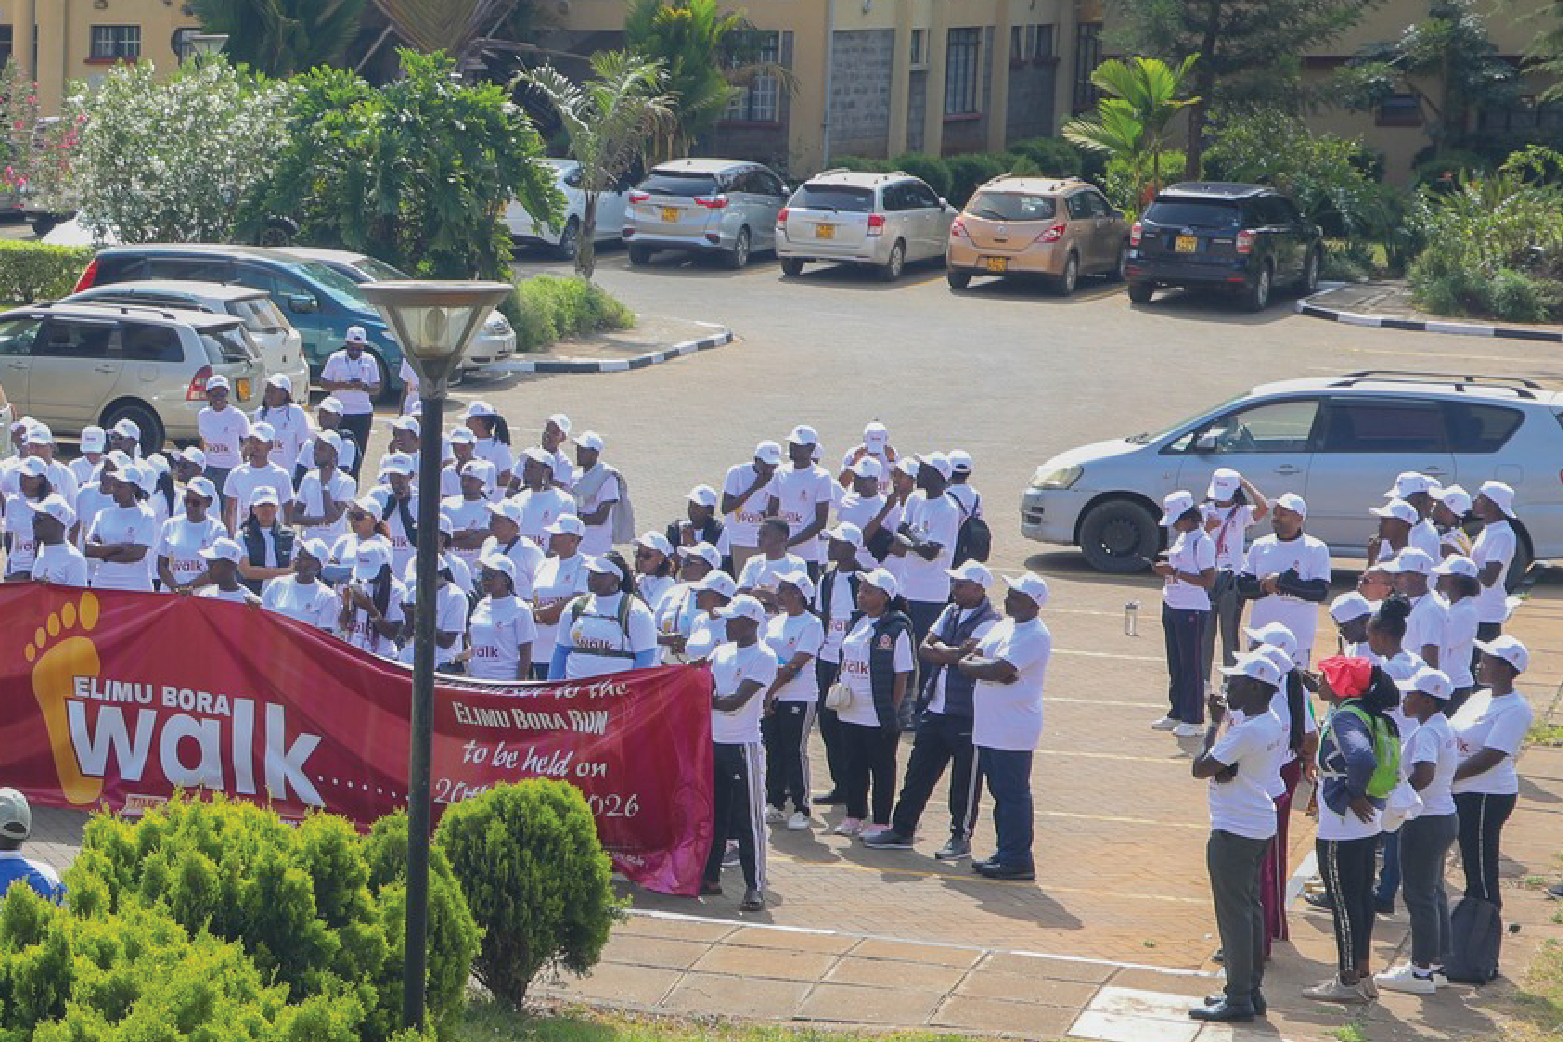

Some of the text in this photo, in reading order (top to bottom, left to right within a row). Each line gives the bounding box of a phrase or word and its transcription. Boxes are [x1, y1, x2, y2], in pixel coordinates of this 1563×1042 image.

[171, 558, 202, 572] walk
[578, 636, 614, 650] walk
[73, 675, 231, 717] ELIMU BORA
[511, 708, 569, 730] BORA
[567, 709, 610, 735] RUN
[462, 739, 609, 778] to be held on
[588, 793, 639, 817] 026
